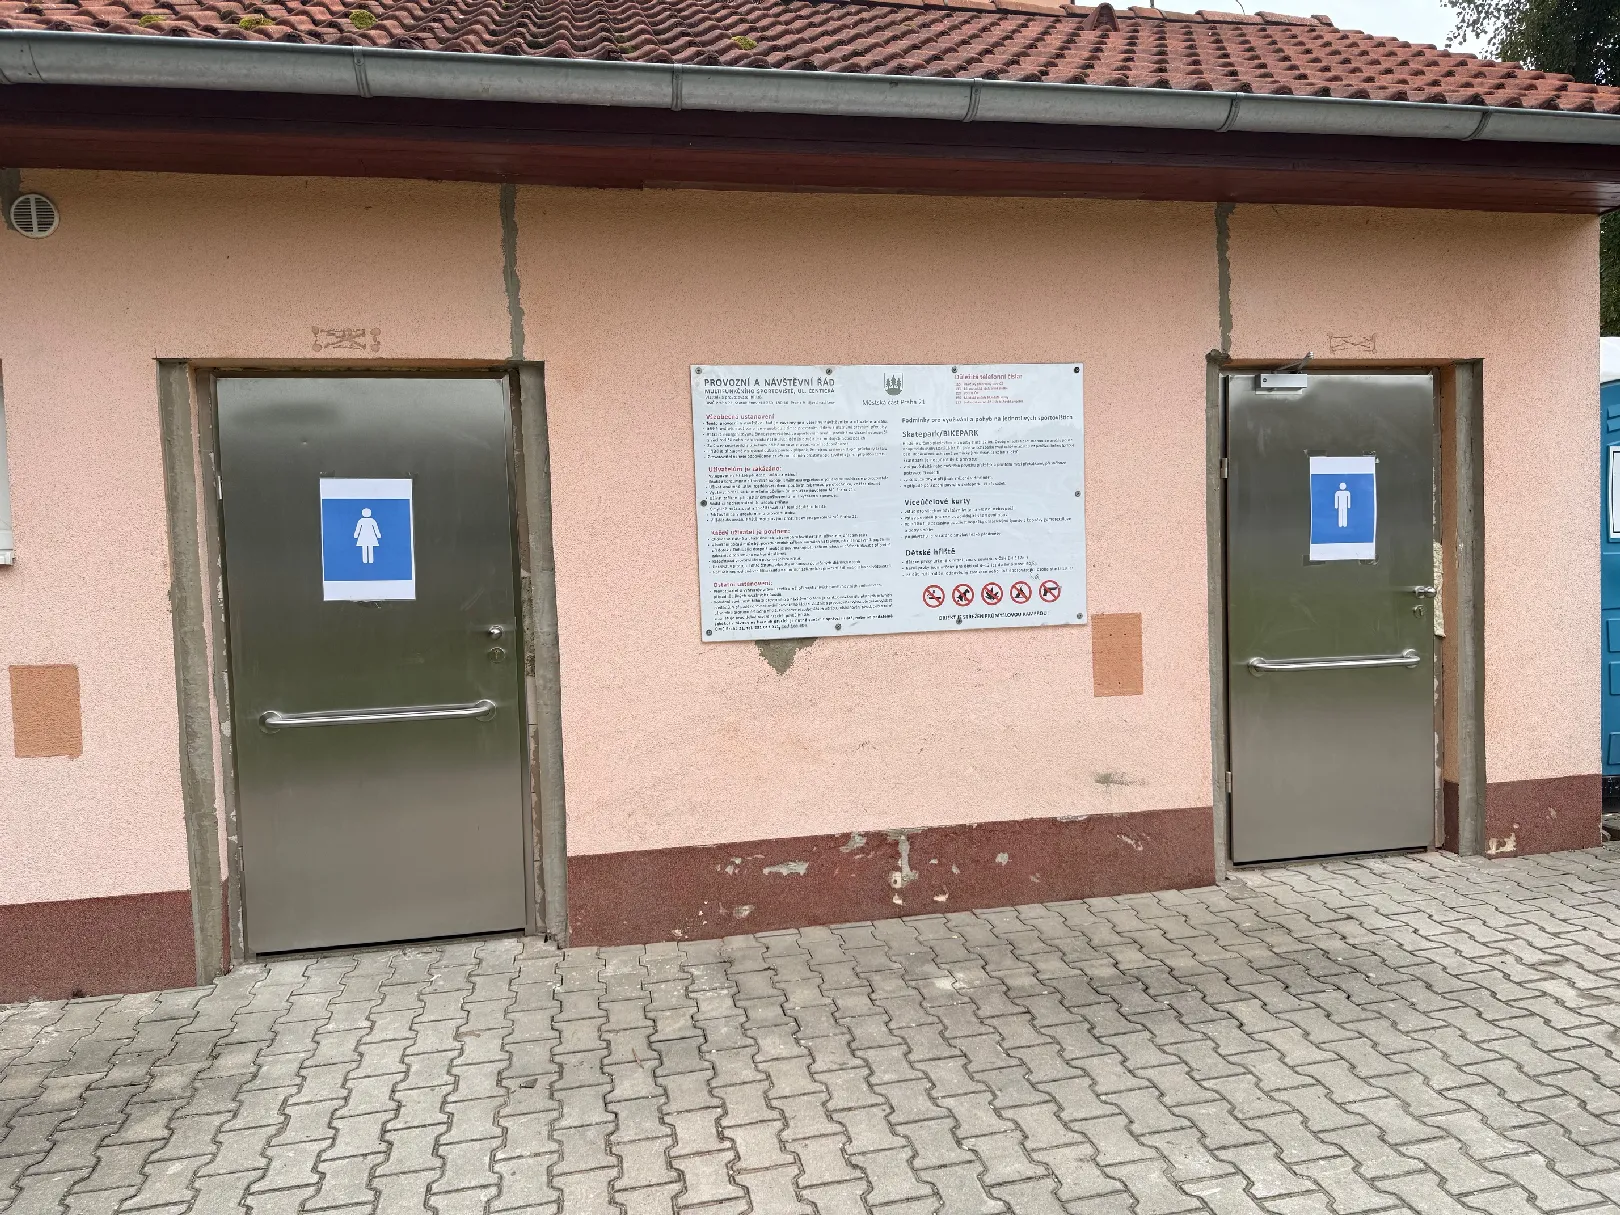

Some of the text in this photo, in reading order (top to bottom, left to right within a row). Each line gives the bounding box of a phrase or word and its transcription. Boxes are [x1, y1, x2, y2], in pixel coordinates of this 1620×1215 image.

[704, 376, 835, 387] PROVOZNÍ A NÁVŠTĚVNÍ ŘÁD
[902, 429, 979, 438] Skatepark/BIKEPARK
[951, 497, 971, 506] kurty
[905, 547, 956, 556] Dětské hřiště
